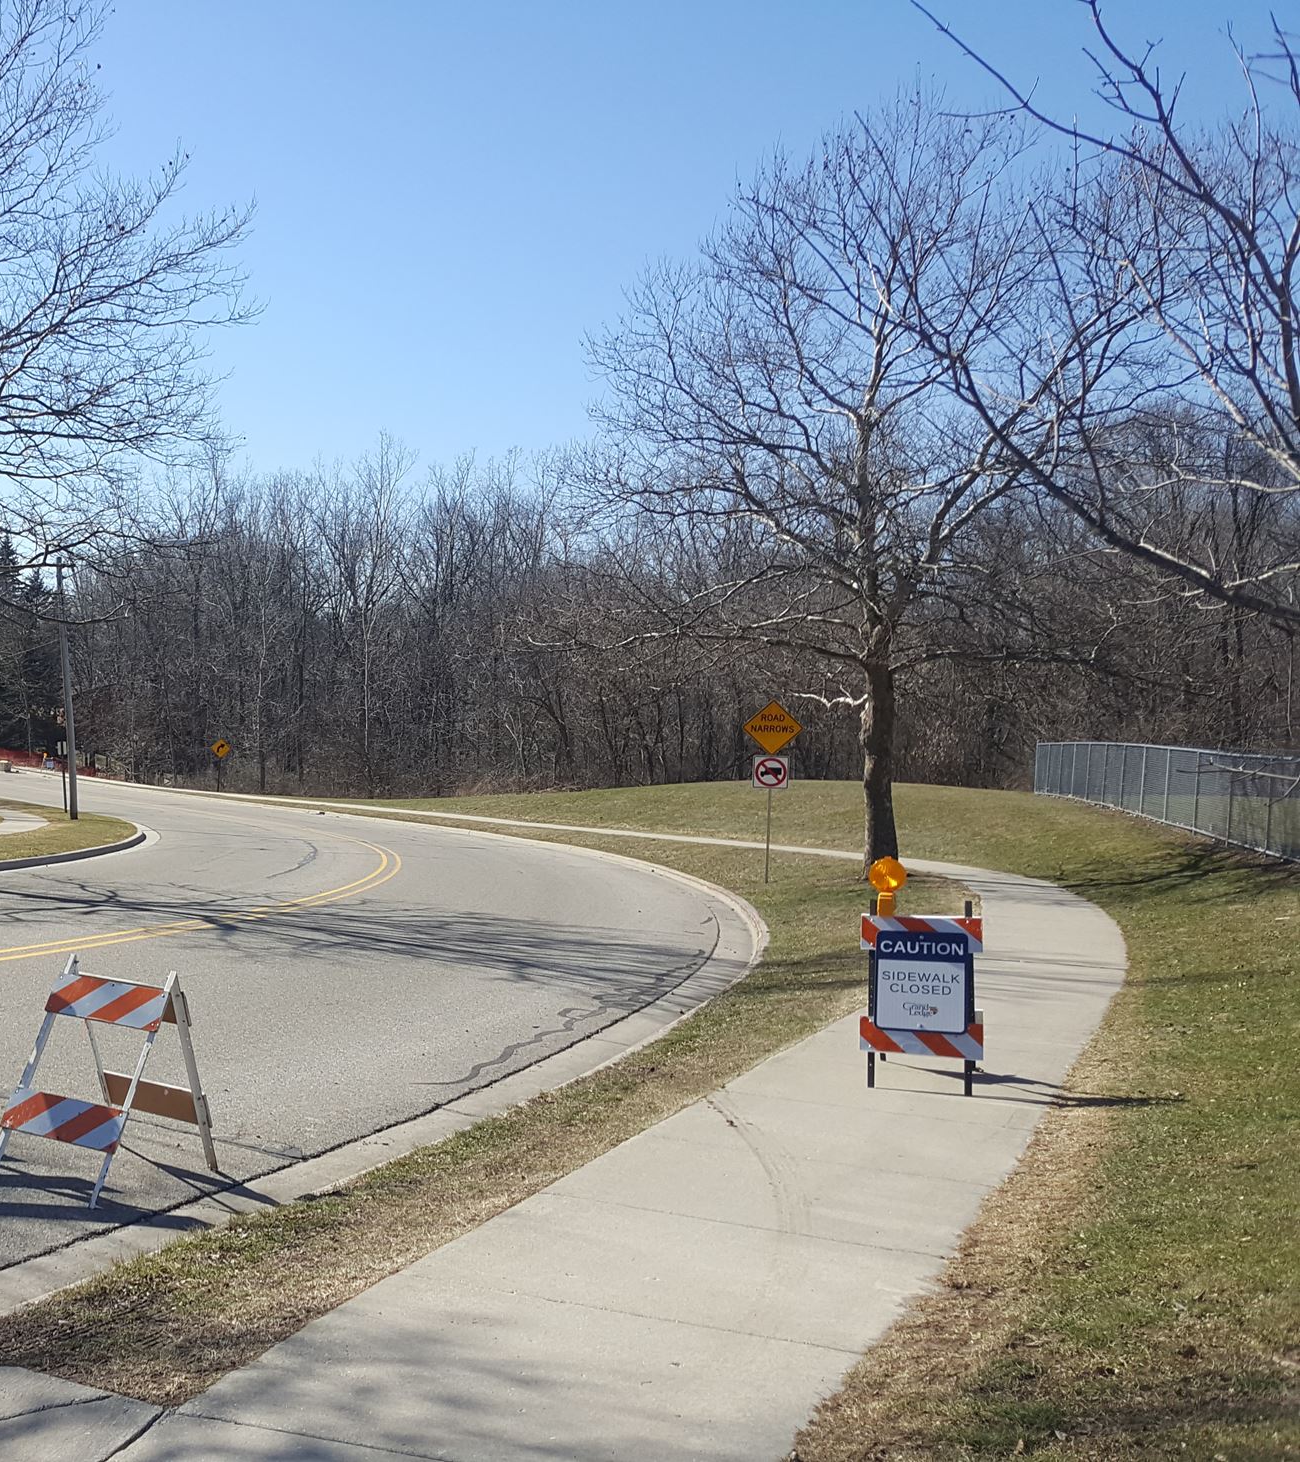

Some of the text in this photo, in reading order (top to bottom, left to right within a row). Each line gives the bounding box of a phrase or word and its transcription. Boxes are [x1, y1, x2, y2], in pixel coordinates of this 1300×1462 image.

[760, 713, 786, 722] ROAD
[750, 724, 795, 734] NARROWS
[880, 940, 964, 956] CAUTION
[881, 970, 960, 984] SIDEWALK
[889, 982, 952, 996] CLOSED
